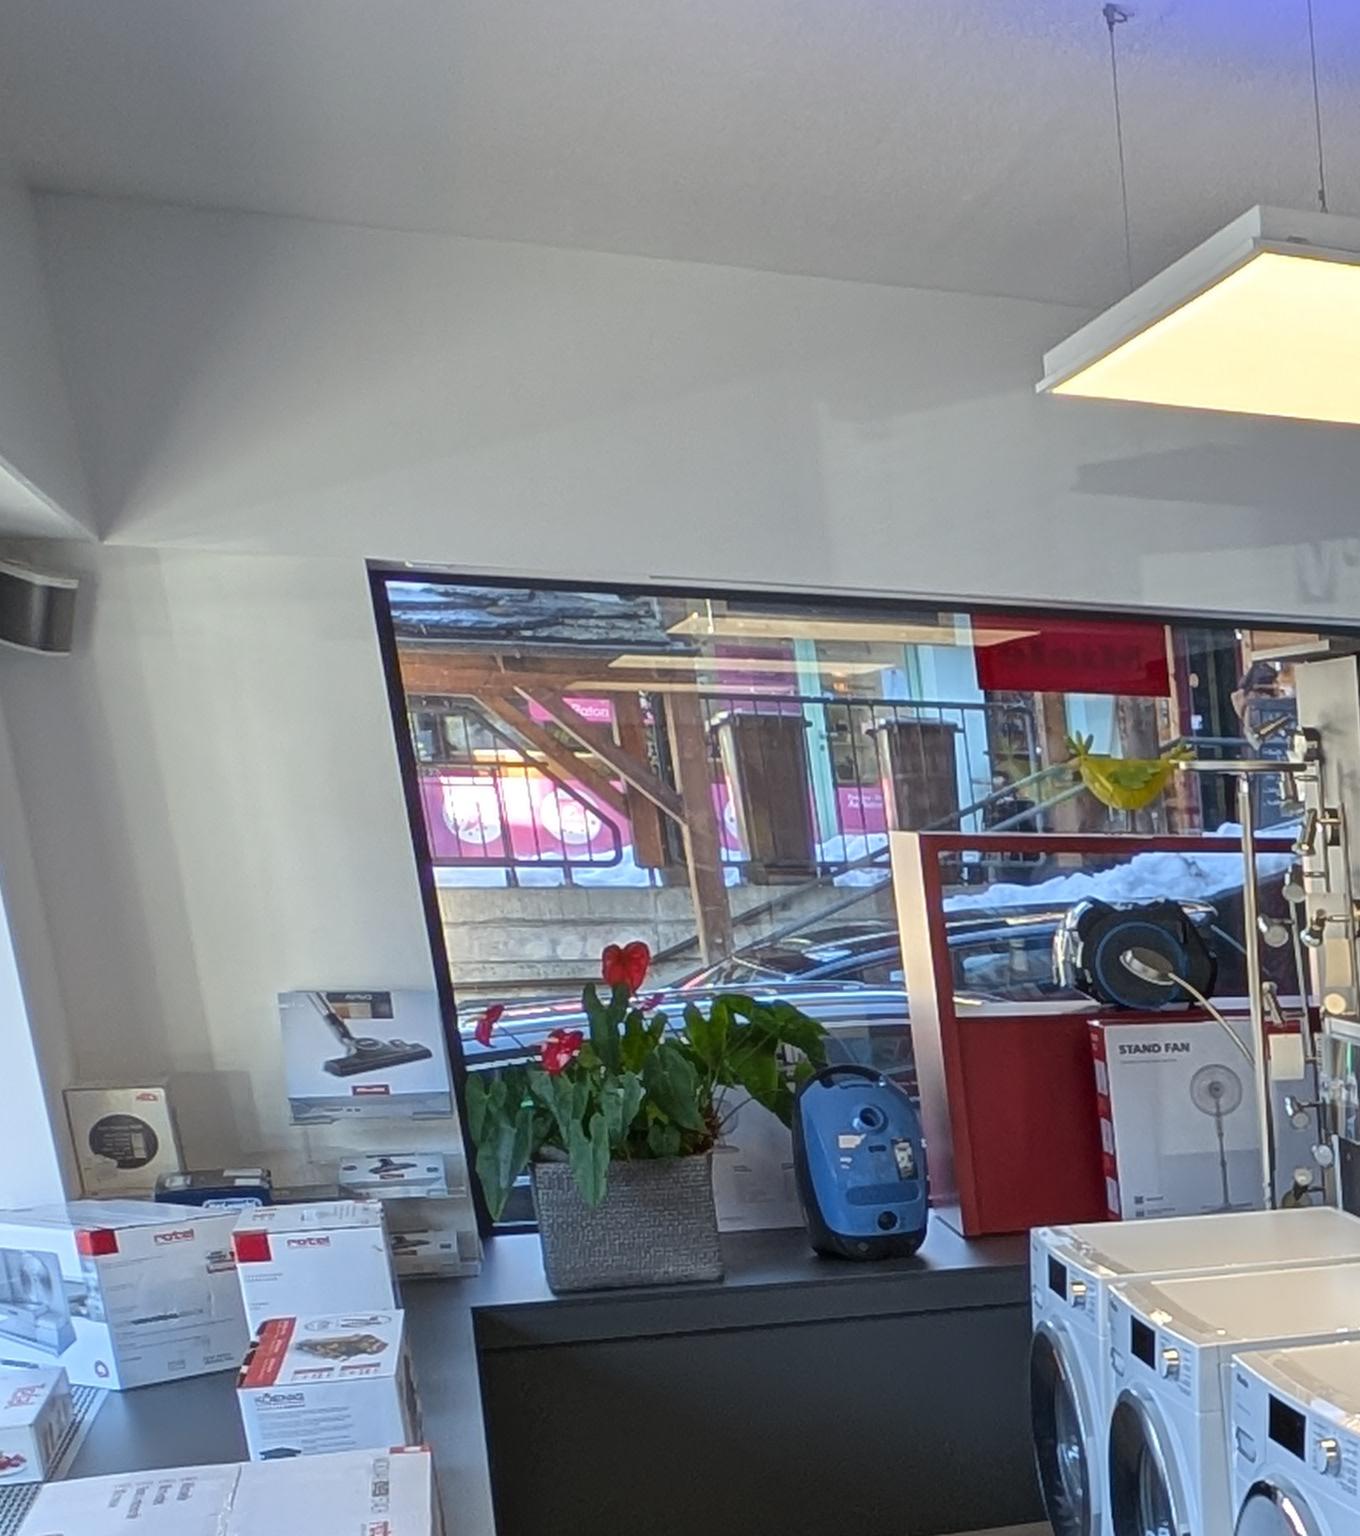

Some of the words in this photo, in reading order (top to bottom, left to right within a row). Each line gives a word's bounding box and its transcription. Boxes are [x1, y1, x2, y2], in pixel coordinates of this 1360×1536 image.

[1119, 1044, 1161, 1054] STAND
[1165, 1043, 1190, 1052] FAN
[287, 1236, 330, 1247] rotel
